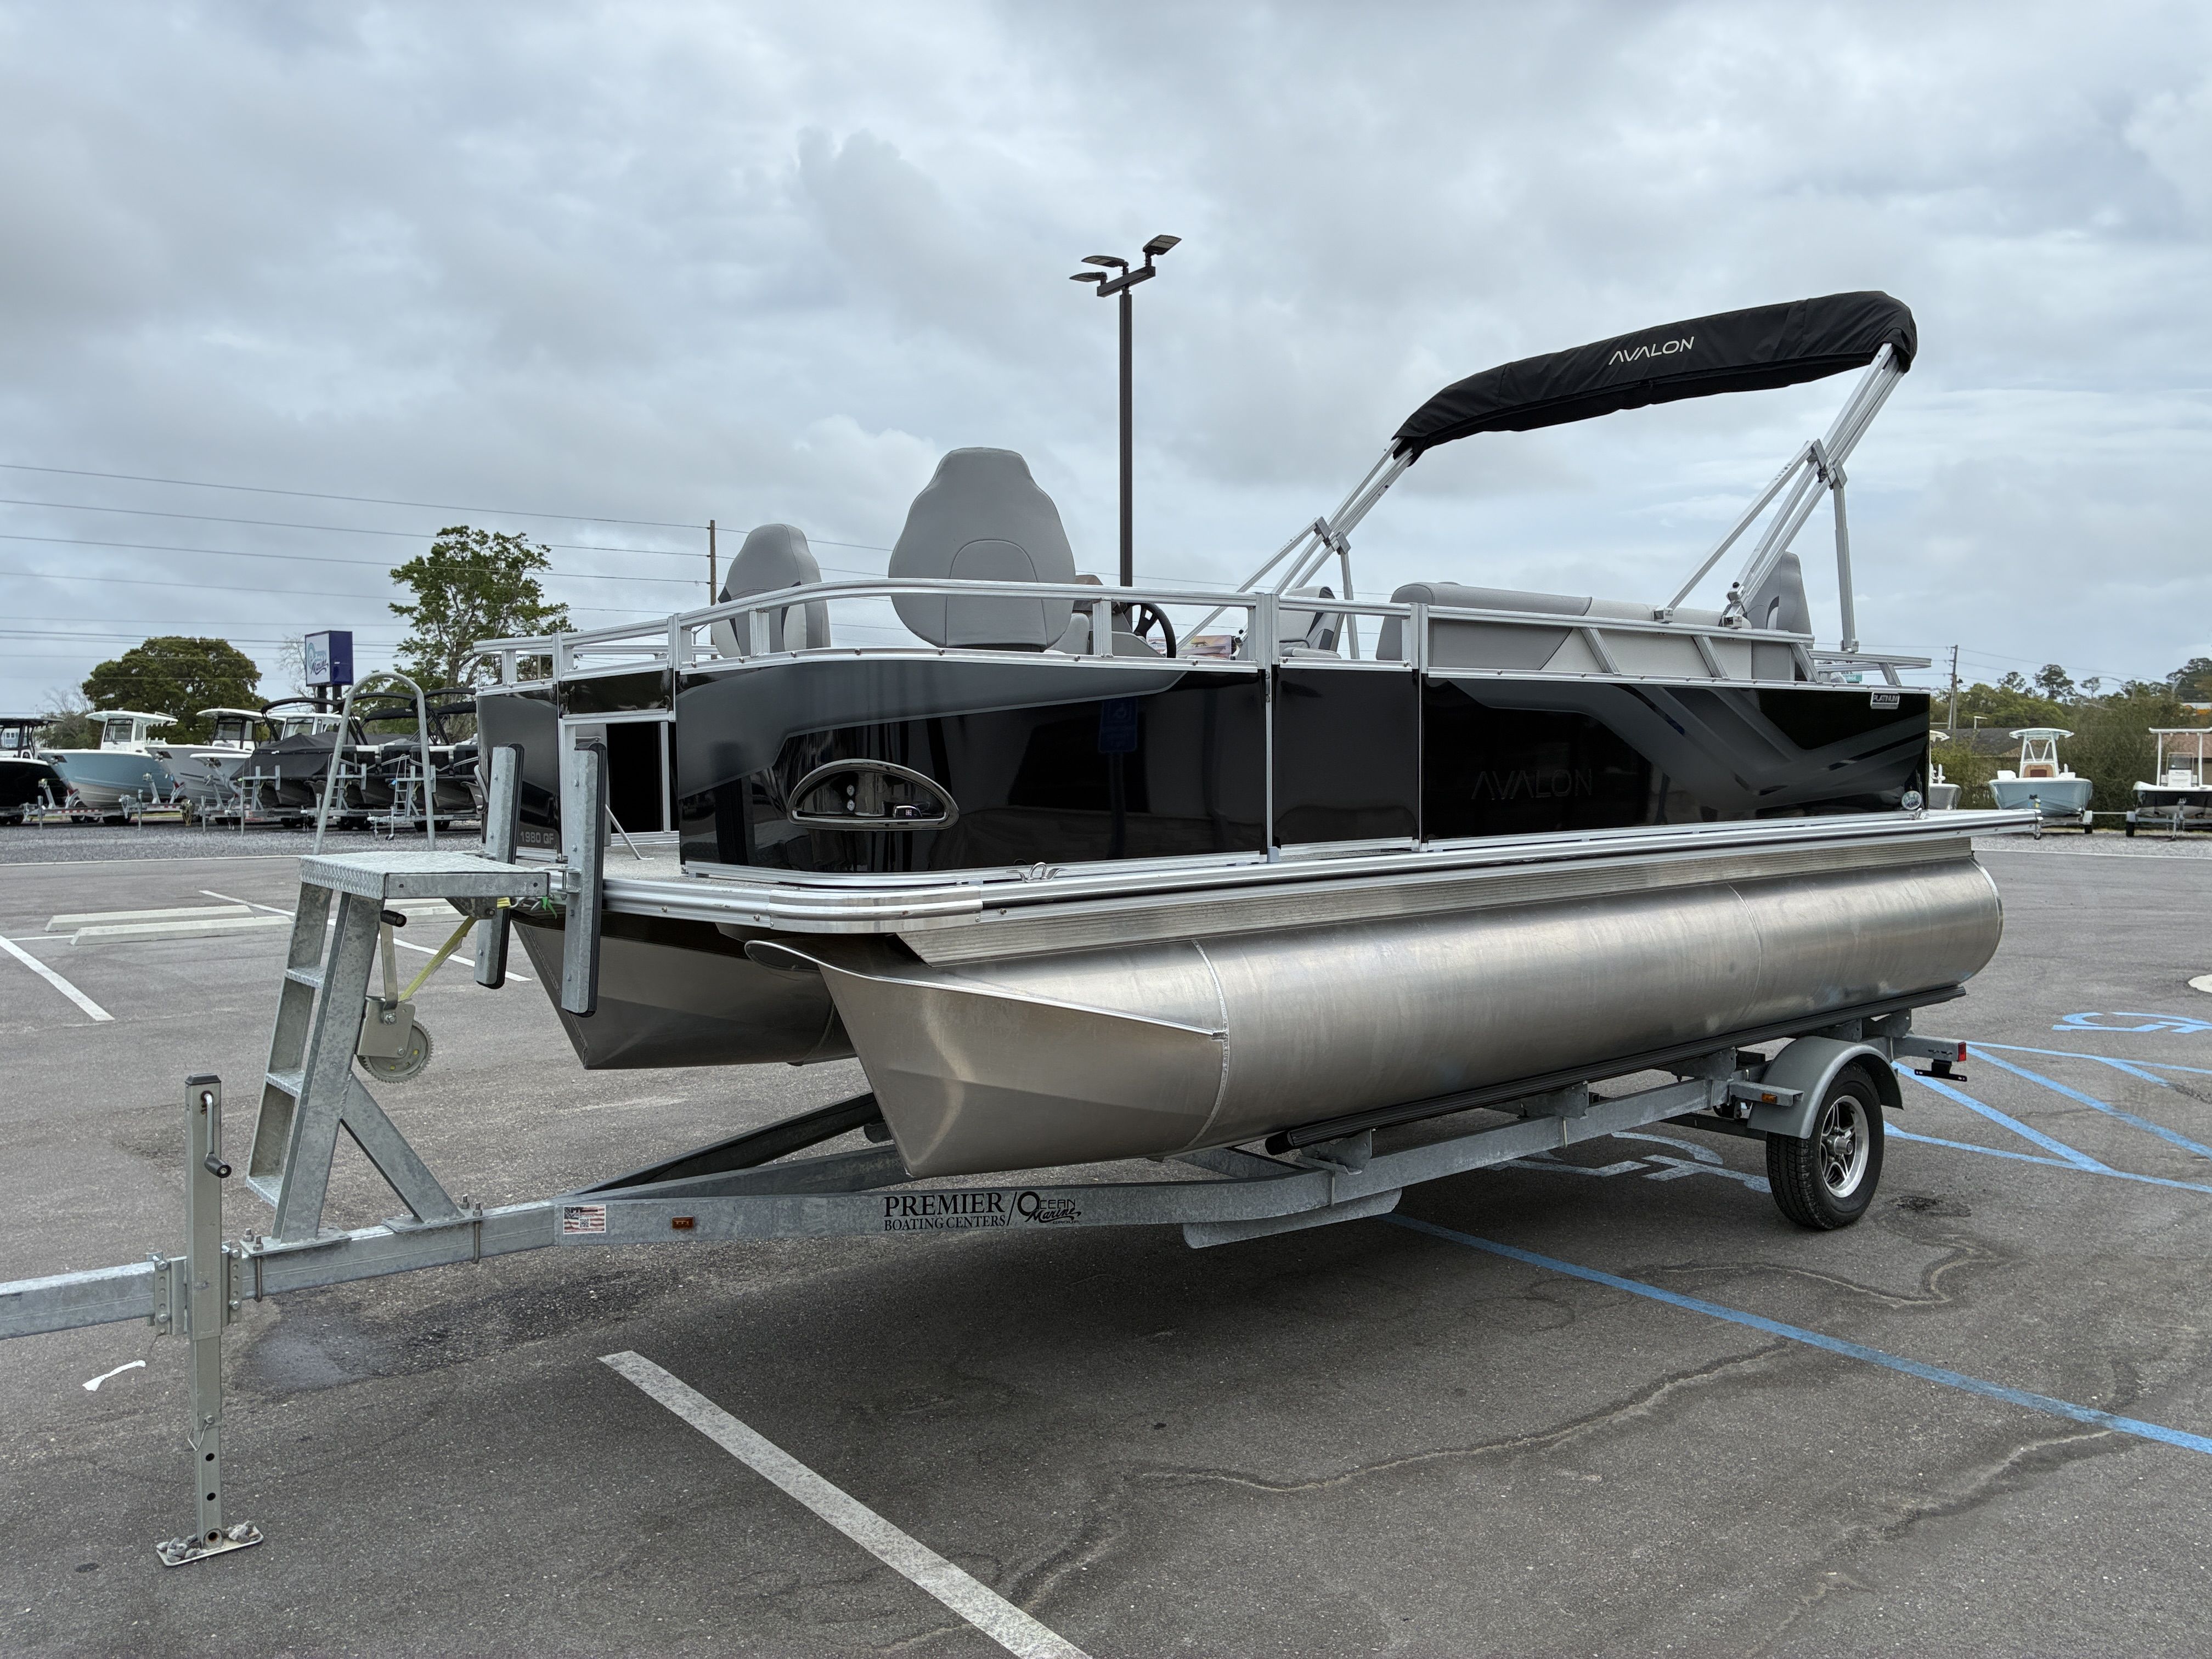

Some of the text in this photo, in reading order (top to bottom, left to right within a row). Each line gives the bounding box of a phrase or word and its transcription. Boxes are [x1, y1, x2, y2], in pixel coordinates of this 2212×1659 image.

[1608, 336, 1695, 365] AVALON
[1872, 694, 1899, 702] PLATINUM
[1470, 769, 1593, 800] AVALON
[520, 831, 541, 843] 1980
[884, 1192, 1005, 1217] PREMIER
[1017, 1191, 1076, 1216] OCEAN
[884, 1215, 1006, 1231] BOATING CENTERS
[1024, 1207, 1082, 1223] Marine
